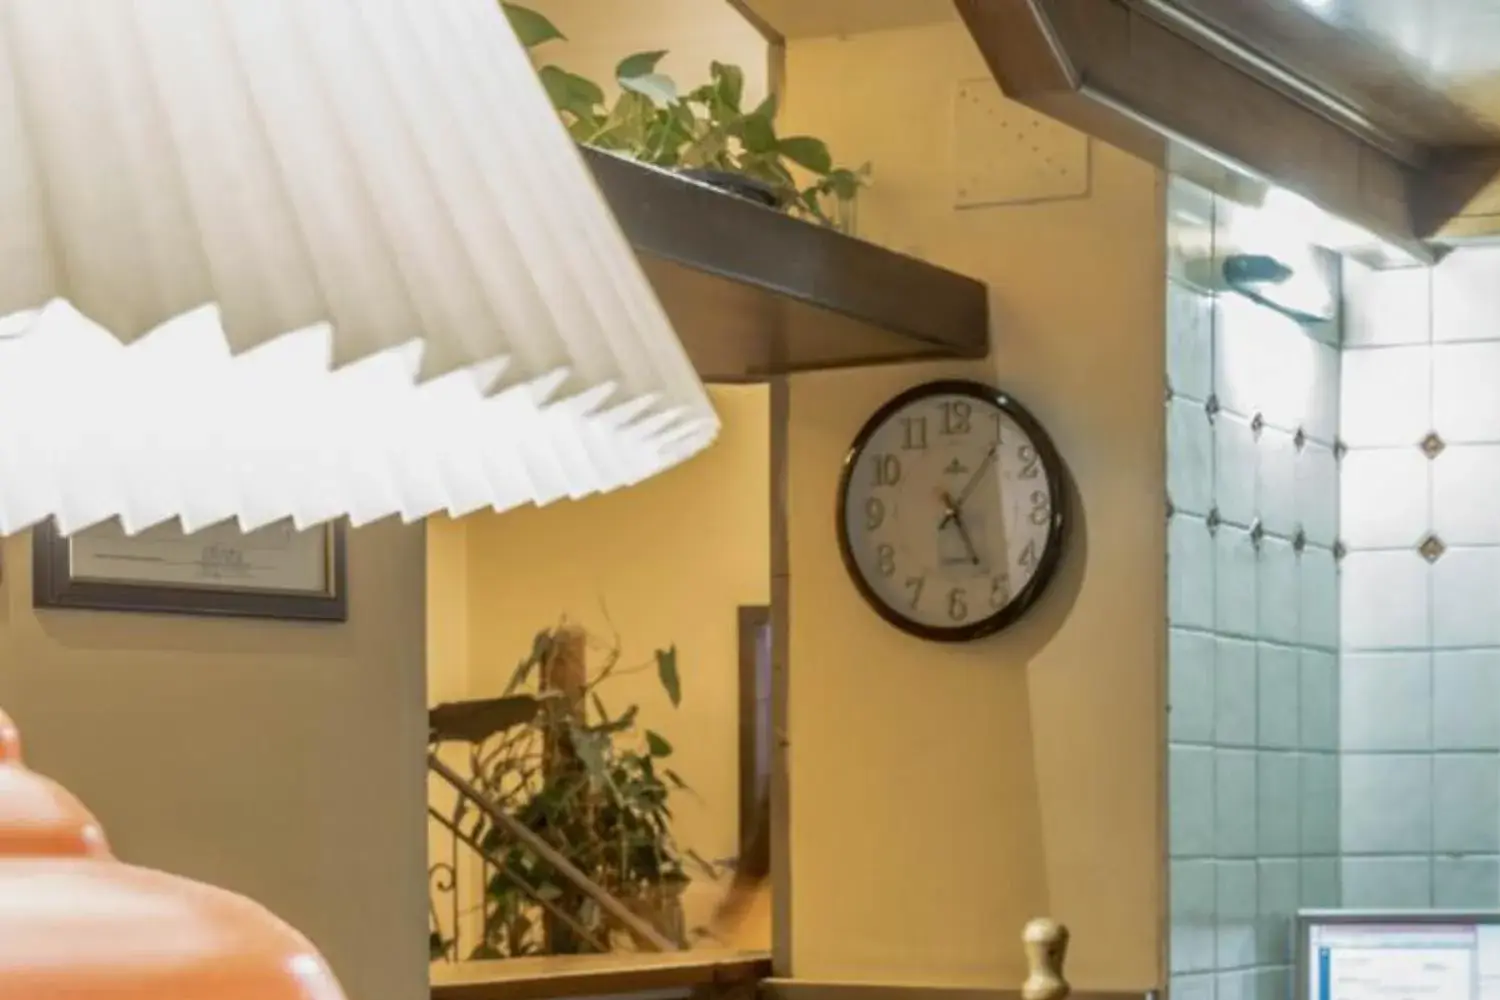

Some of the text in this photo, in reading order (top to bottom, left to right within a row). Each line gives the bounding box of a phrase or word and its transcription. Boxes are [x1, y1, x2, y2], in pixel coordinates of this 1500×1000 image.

[901, 416, 928, 450] 11
[939, 402, 972, 435] 12
[872, 454, 901, 487] 10
[1017, 445, 1038, 479] 2
[865, 497, 885, 531] 9
[877, 545, 896, 577] 8
[905, 577, 926, 610] 7
[948, 588, 968, 621] 6
